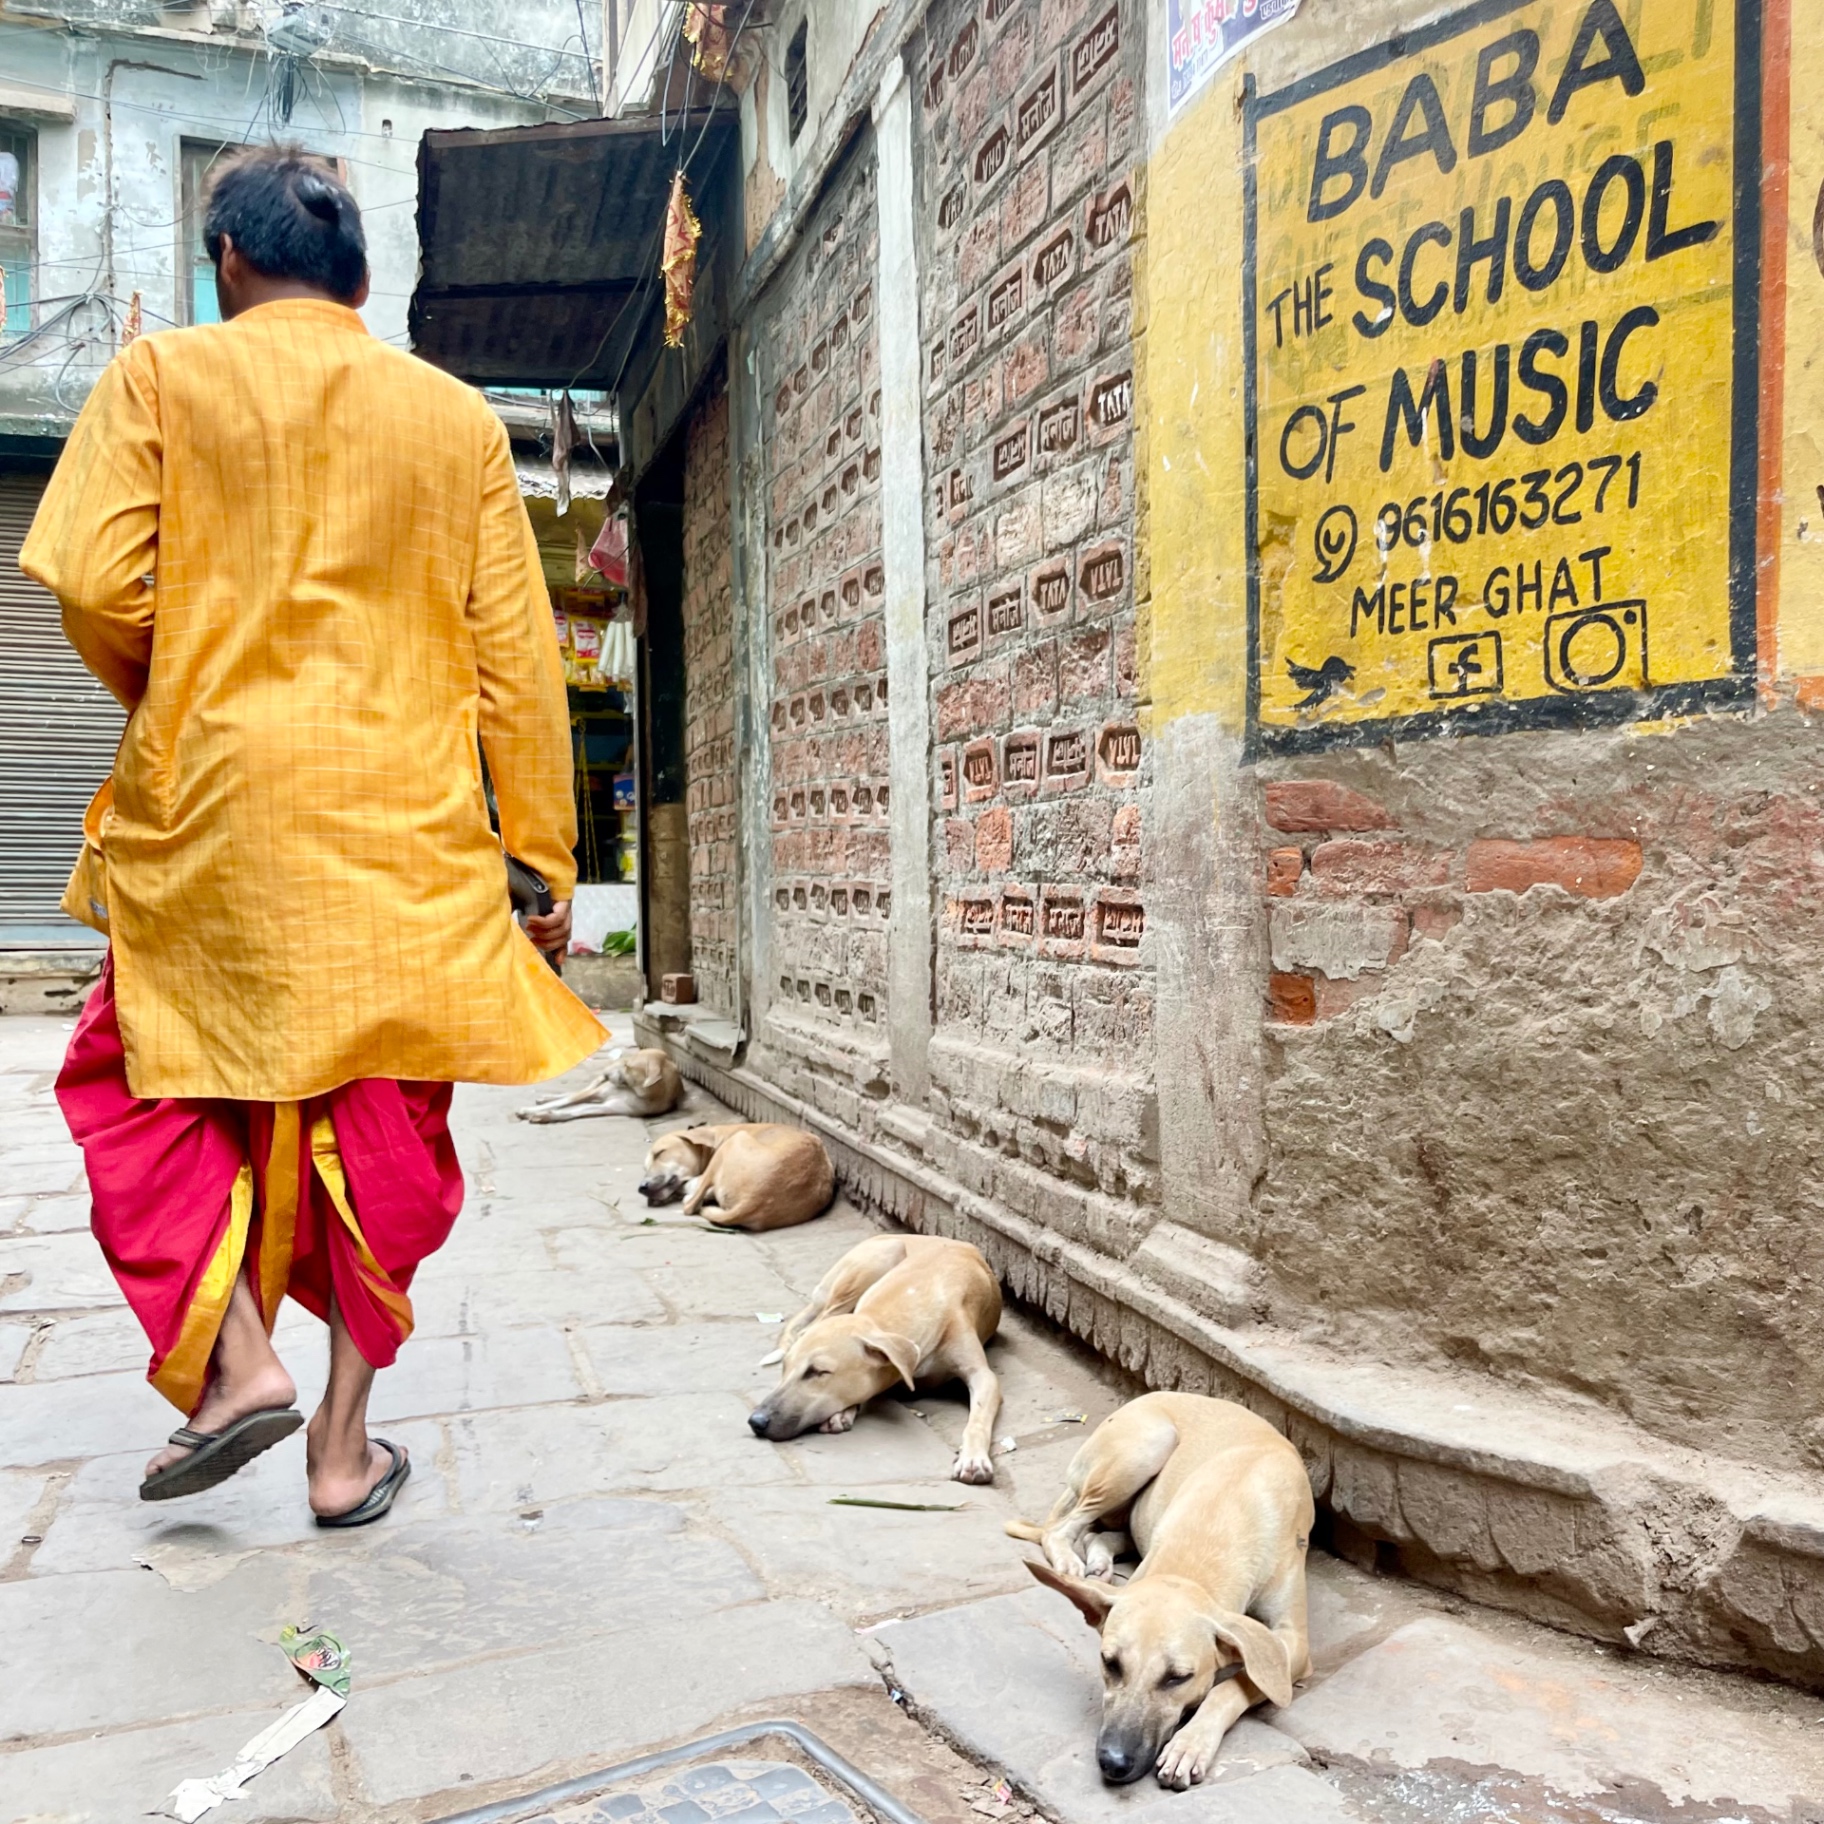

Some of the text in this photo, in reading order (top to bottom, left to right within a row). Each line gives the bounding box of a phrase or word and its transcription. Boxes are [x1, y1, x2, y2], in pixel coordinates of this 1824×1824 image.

[1307, 0, 1645, 223] BABA
[1095, 201, 1129, 245] TATA
[1266, 262, 1334, 348] THE
[1352, 140, 1719, 338] SCHOOL
[1042, 240, 1069, 283] TATA
[1098, 380, 1131, 423] TATA
[1279, 306, 1659, 483] OF MUSIC
[1376, 451, 1641, 551] 9616163271
[1040, 577, 1067, 610] TATA
[1090, 559, 1123, 595] TATA
[1351, 547, 1611, 638] MEER GHAT
[1109, 735, 1140, 765] TATA
